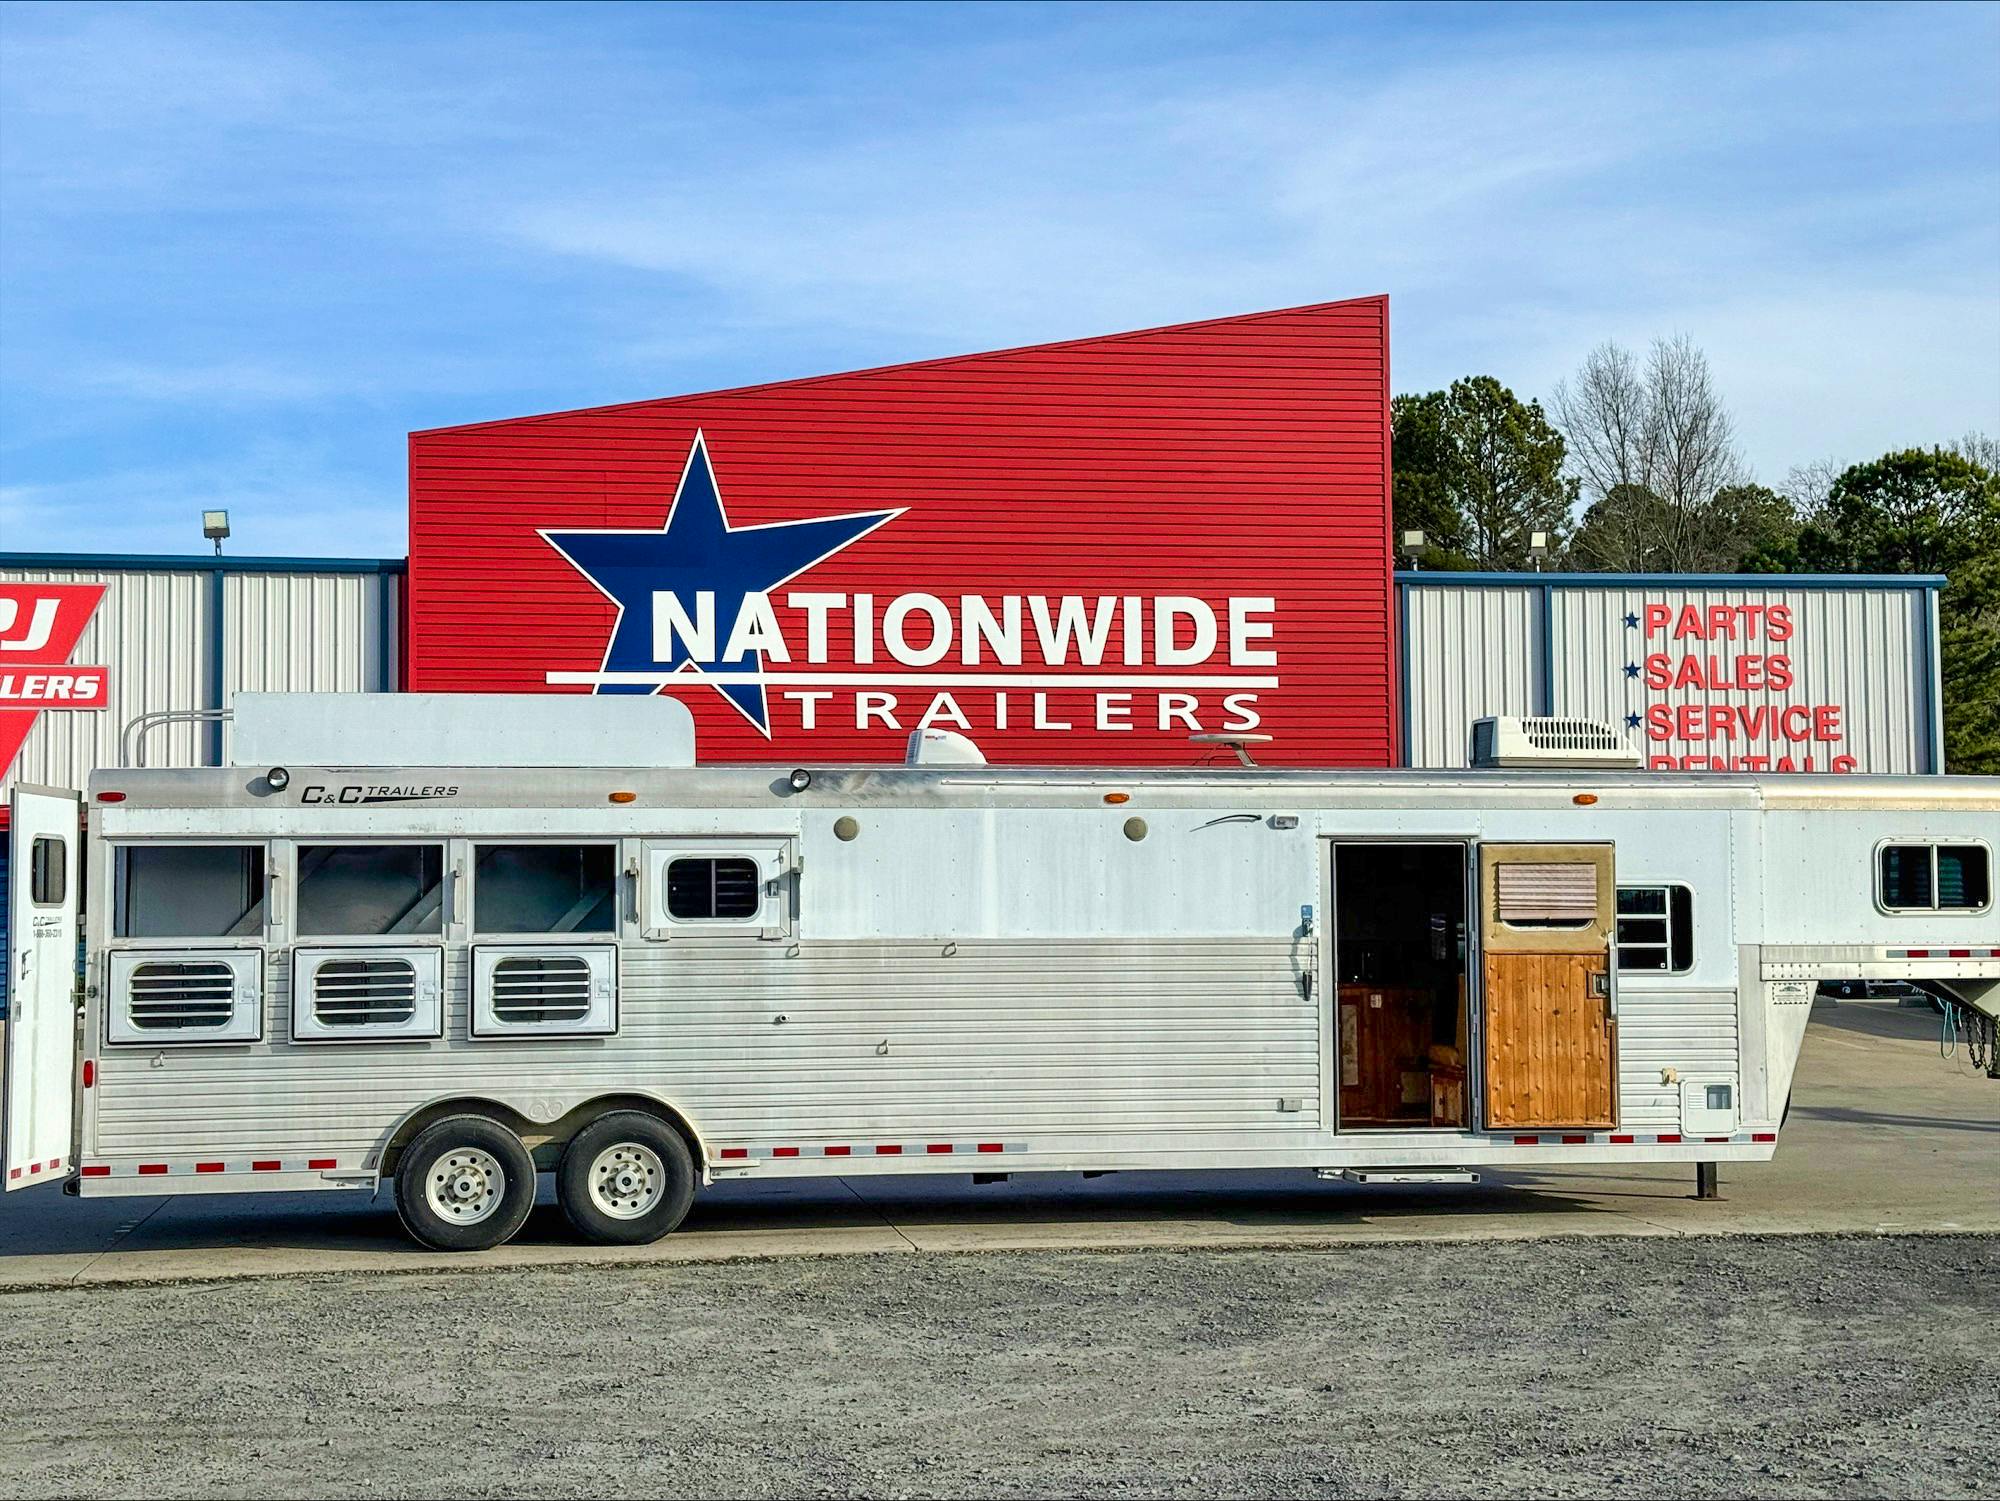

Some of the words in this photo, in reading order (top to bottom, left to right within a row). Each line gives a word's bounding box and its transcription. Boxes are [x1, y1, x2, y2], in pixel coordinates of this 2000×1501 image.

[652, 590, 1278, 667] NATIONWIDE
[1645, 604, 1794, 641] PARTS
[1644, 653, 1793, 690] SALES
[783, 691, 1262, 731] TRAILERS
[1646, 703, 1843, 741] SERVICE
[301, 786, 363, 804] C&C
[367, 786, 459, 796] TRAILERS
